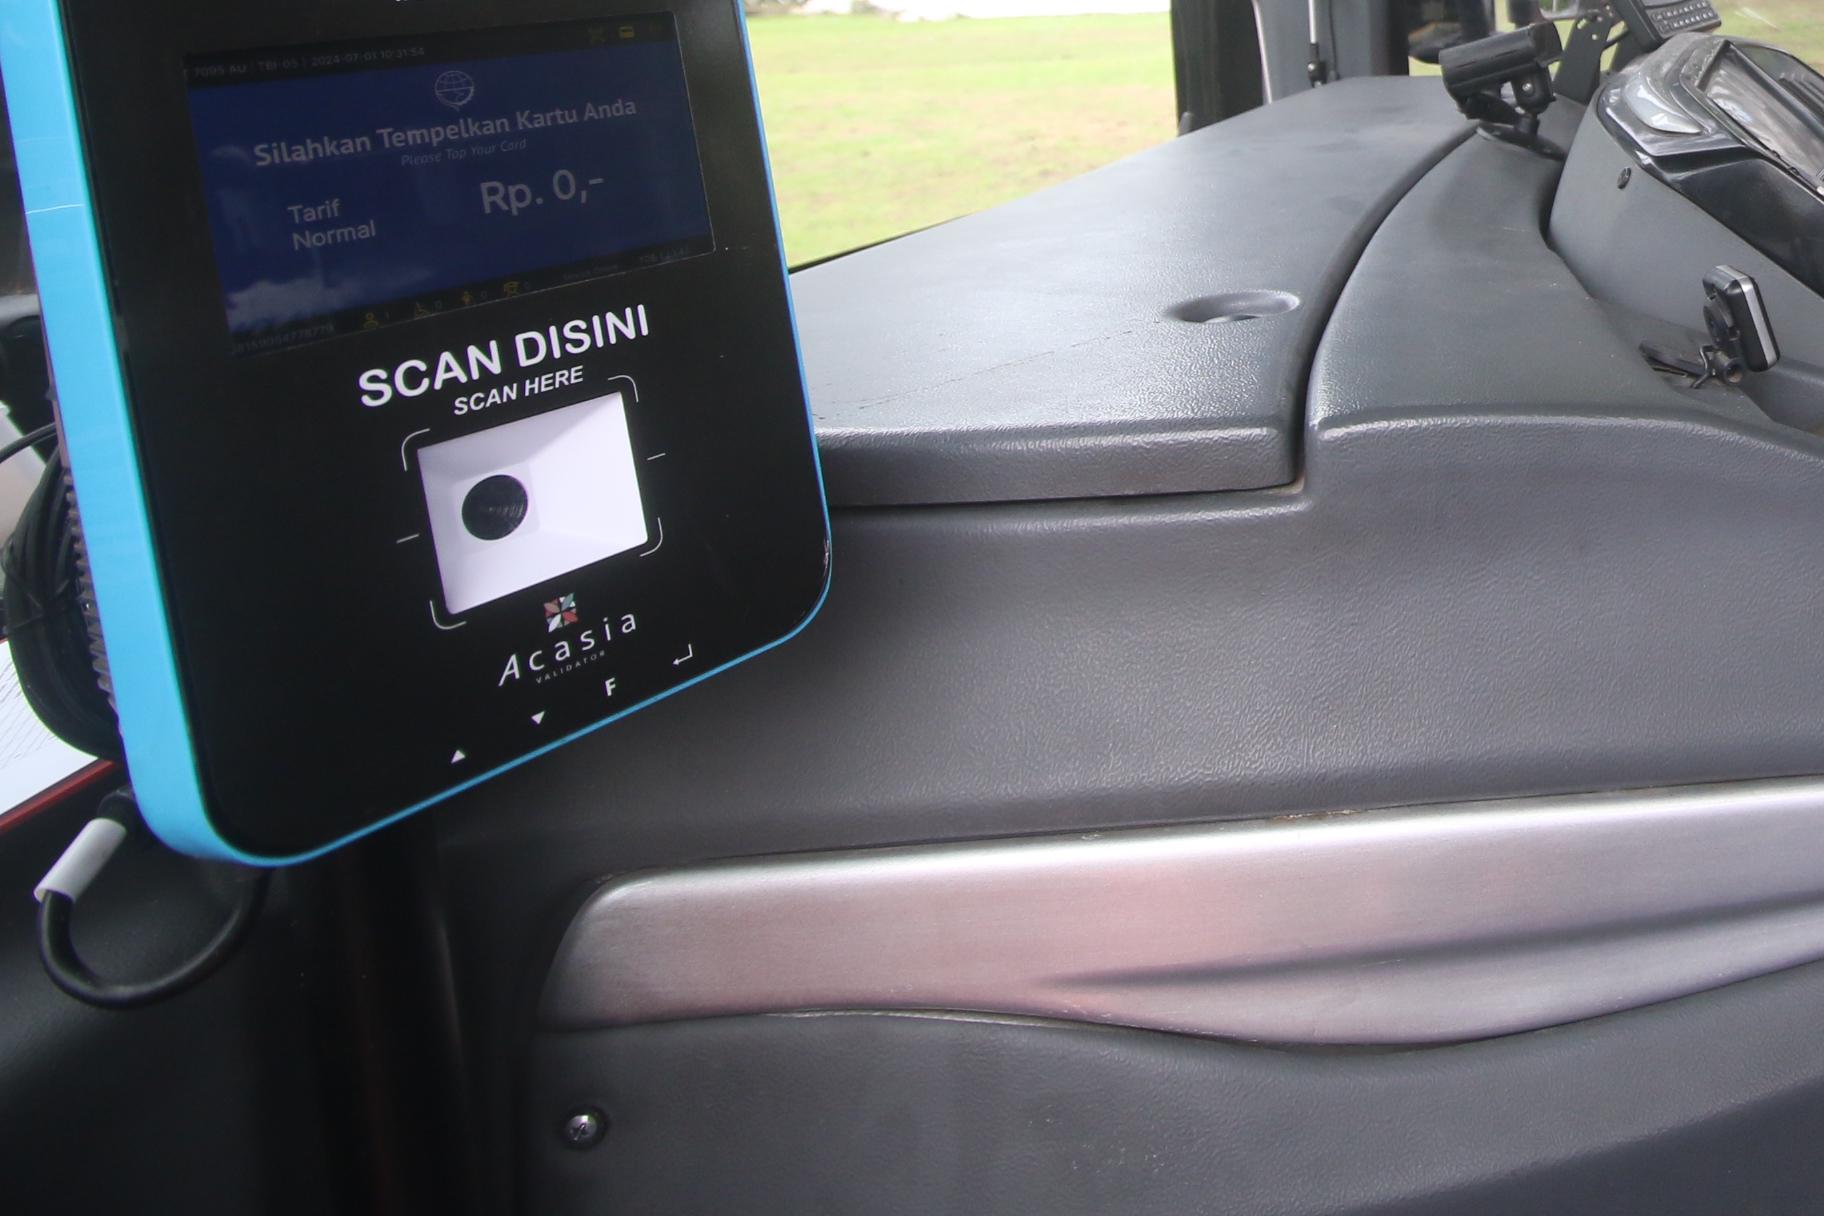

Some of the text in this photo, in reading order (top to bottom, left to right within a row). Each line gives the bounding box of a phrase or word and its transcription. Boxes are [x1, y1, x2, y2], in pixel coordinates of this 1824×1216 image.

[254, 98, 638, 167] Silahkan Tempelkan Kartu Anda
[401, 151, 442, 167] Please
[470, 143, 497, 158] Your
[500, 137, 527, 154] Card
[287, 199, 341, 225] Tarif
[480, 180, 544, 216] Rp.
[292, 220, 376, 251] Normal
[359, 304, 648, 407] SCAN DISINI
[454, 365, 584, 415] SCAN HERE
[498, 613, 637, 687] Acasia
[536, 649, 606, 684] VALIDATOR
[605, 676, 616, 697] F
